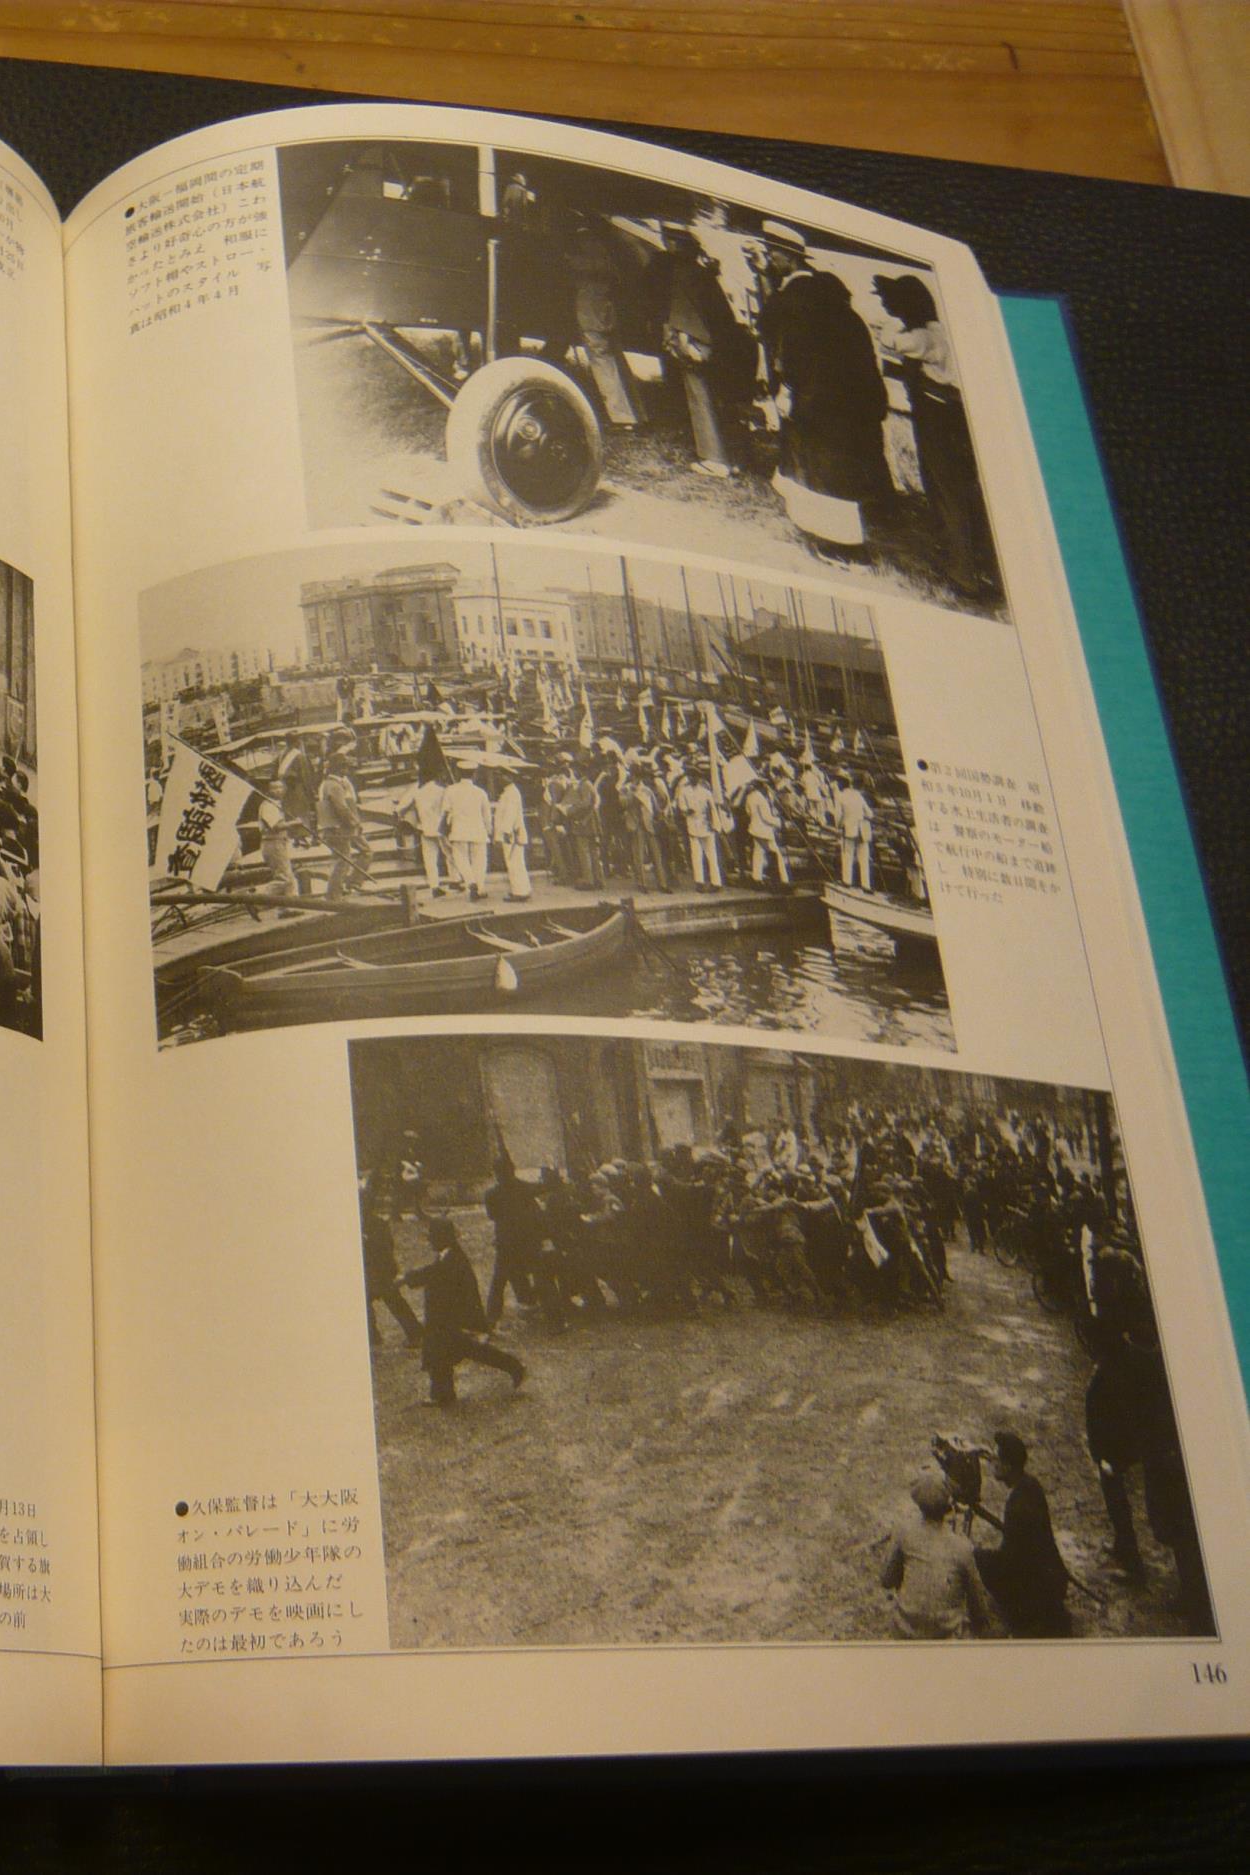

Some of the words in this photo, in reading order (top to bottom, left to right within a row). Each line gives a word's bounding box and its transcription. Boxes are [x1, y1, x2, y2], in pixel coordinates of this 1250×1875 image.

[177, 1545, 361, 1573] 働組合の労働少年隊の
[178, 1573, 343, 1600] 大デモを織り込んだ
[179, 1601, 364, 1627] 実際のデモを映画にし
[180, 1629, 344, 1654] たのは最初であろう
[1190, 1662, 1228, 1684] 146
